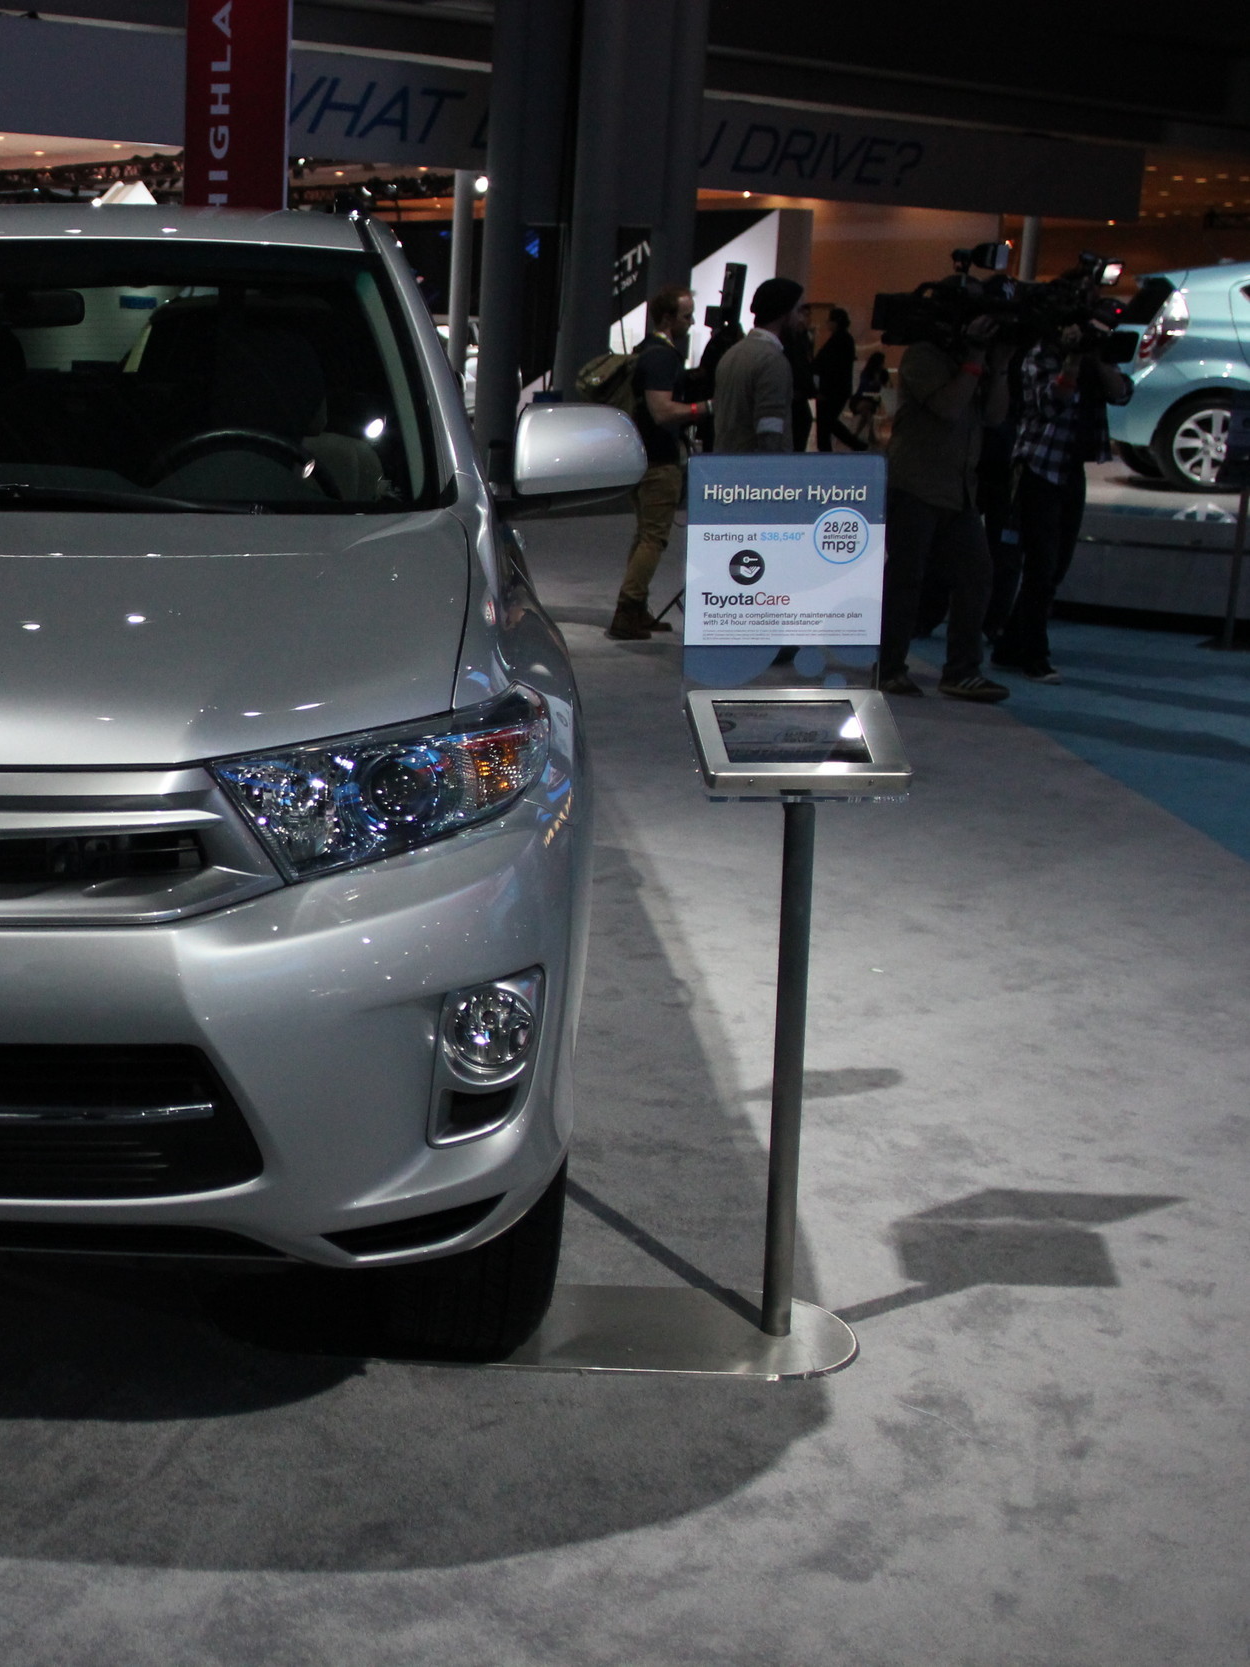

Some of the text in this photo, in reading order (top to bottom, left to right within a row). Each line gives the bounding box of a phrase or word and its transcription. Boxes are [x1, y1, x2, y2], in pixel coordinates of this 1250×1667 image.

[731, 124, 925, 187] DRIVE?
[703, 484, 867, 504] Highlander Hybrid
[823, 521, 859, 533] 28/28
[703, 532, 744, 543] Starting
[747, 532, 757, 541] at
[821, 540, 856, 553] mpg
[701, 591, 791, 608] ToyotaCare
[703, 612, 737, 620] Featuring
[745, 612, 798, 620] complimentary
